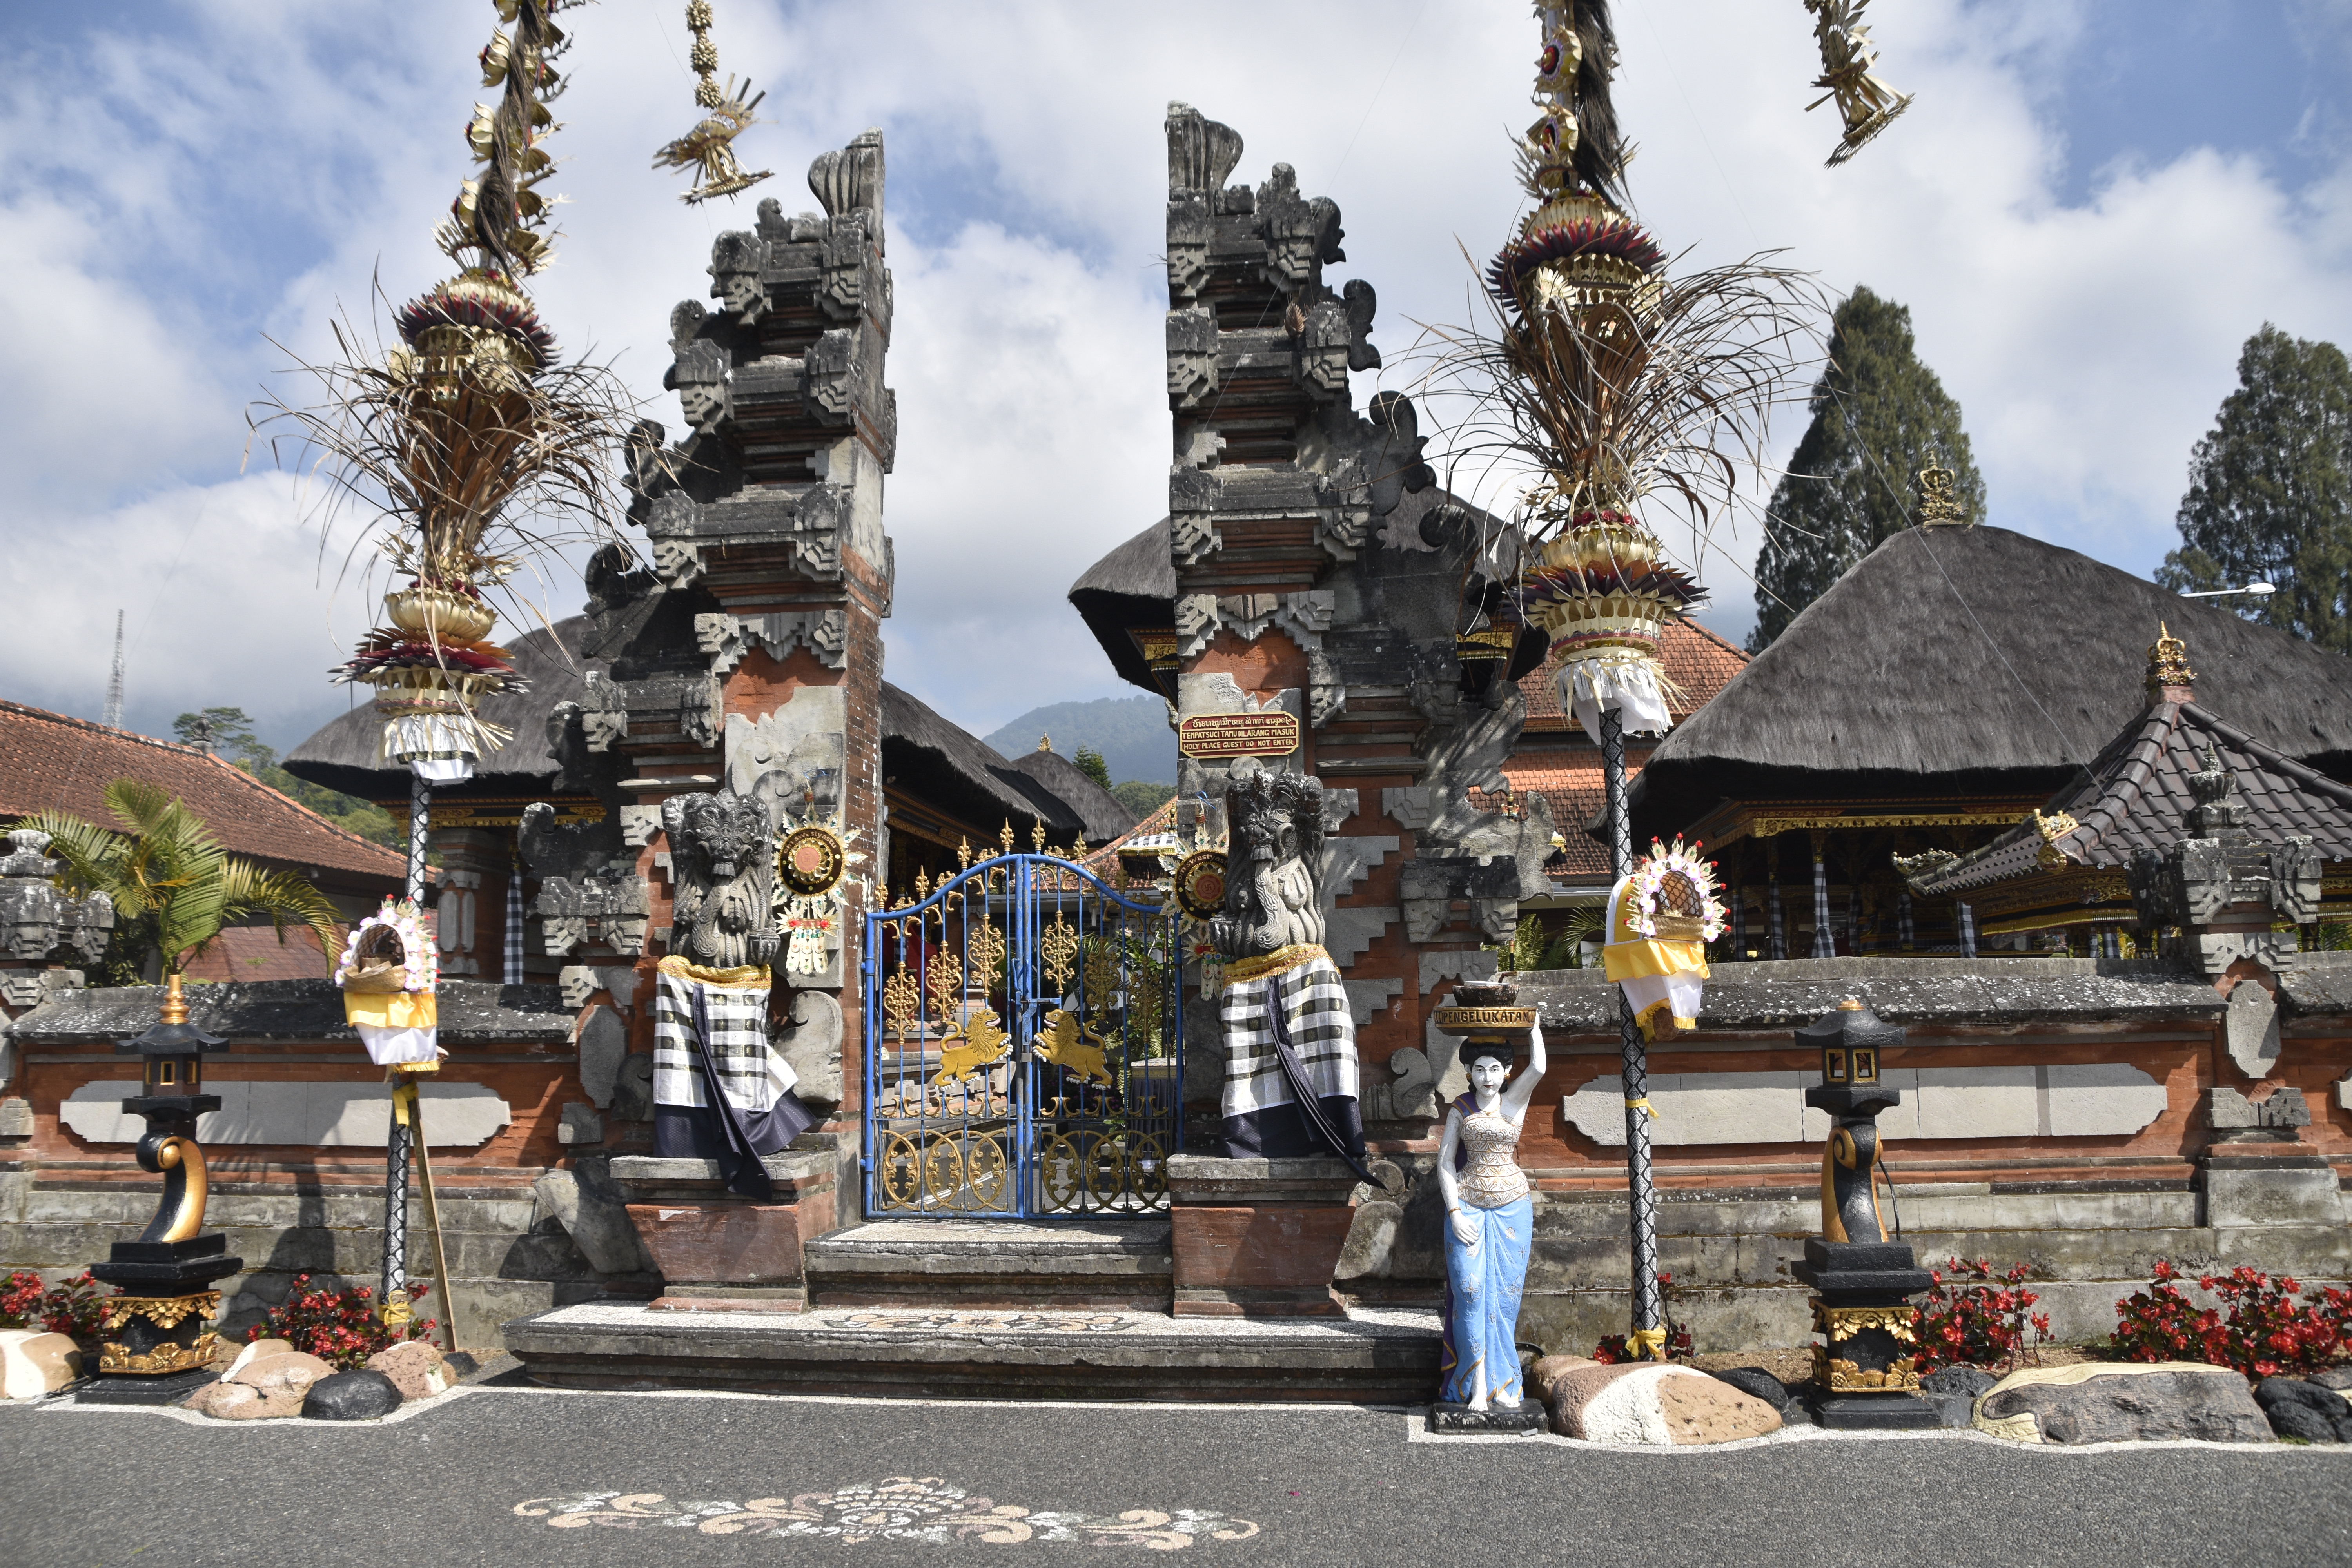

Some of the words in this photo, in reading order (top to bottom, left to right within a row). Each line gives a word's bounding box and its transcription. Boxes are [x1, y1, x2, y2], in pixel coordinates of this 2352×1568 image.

[784, 840, 794, 853] om
[1178, 867, 1186, 881] om
[1186, 854, 1227, 867] swastyast
[1443, 1011, 1528, 1023] PENGELUKATAN
